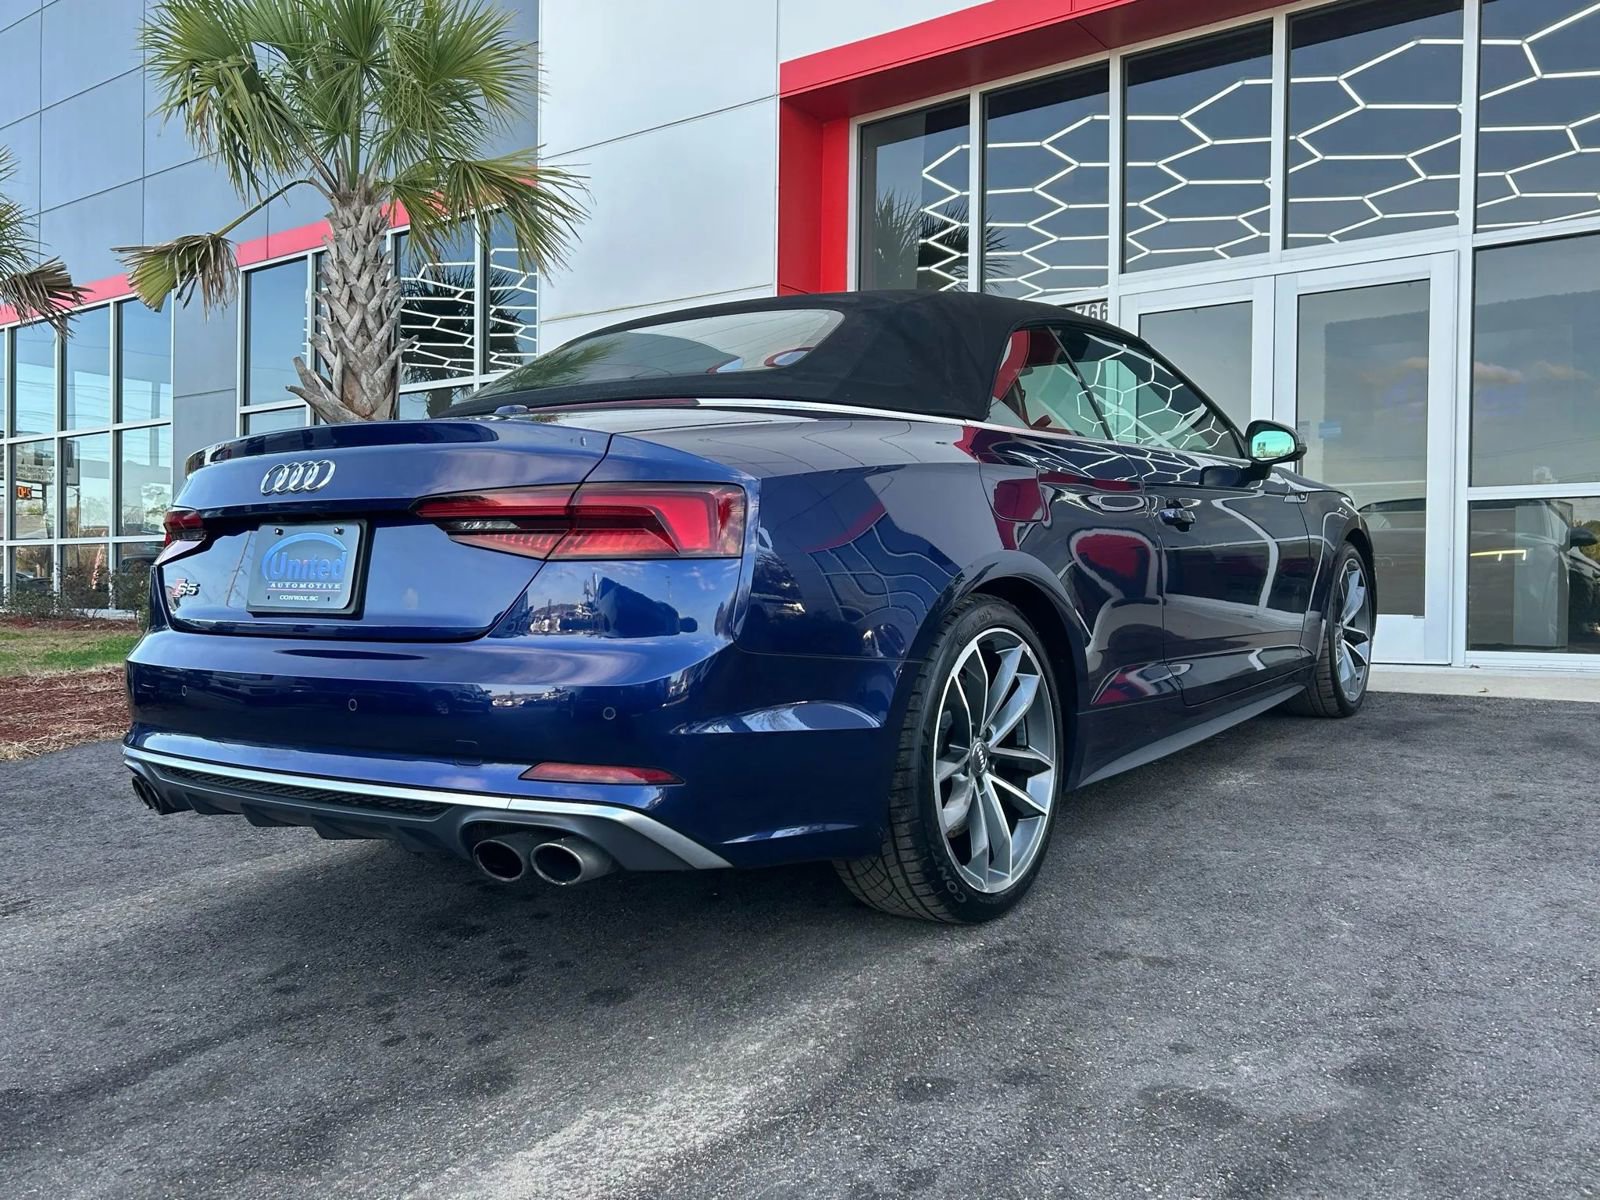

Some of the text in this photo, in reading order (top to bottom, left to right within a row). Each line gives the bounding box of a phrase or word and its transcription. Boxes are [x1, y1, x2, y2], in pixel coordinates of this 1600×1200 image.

[270, 551, 347, 579] United
[177, 582, 200, 597] S5
[270, 582, 341, 590] AUTOMOTIVE
